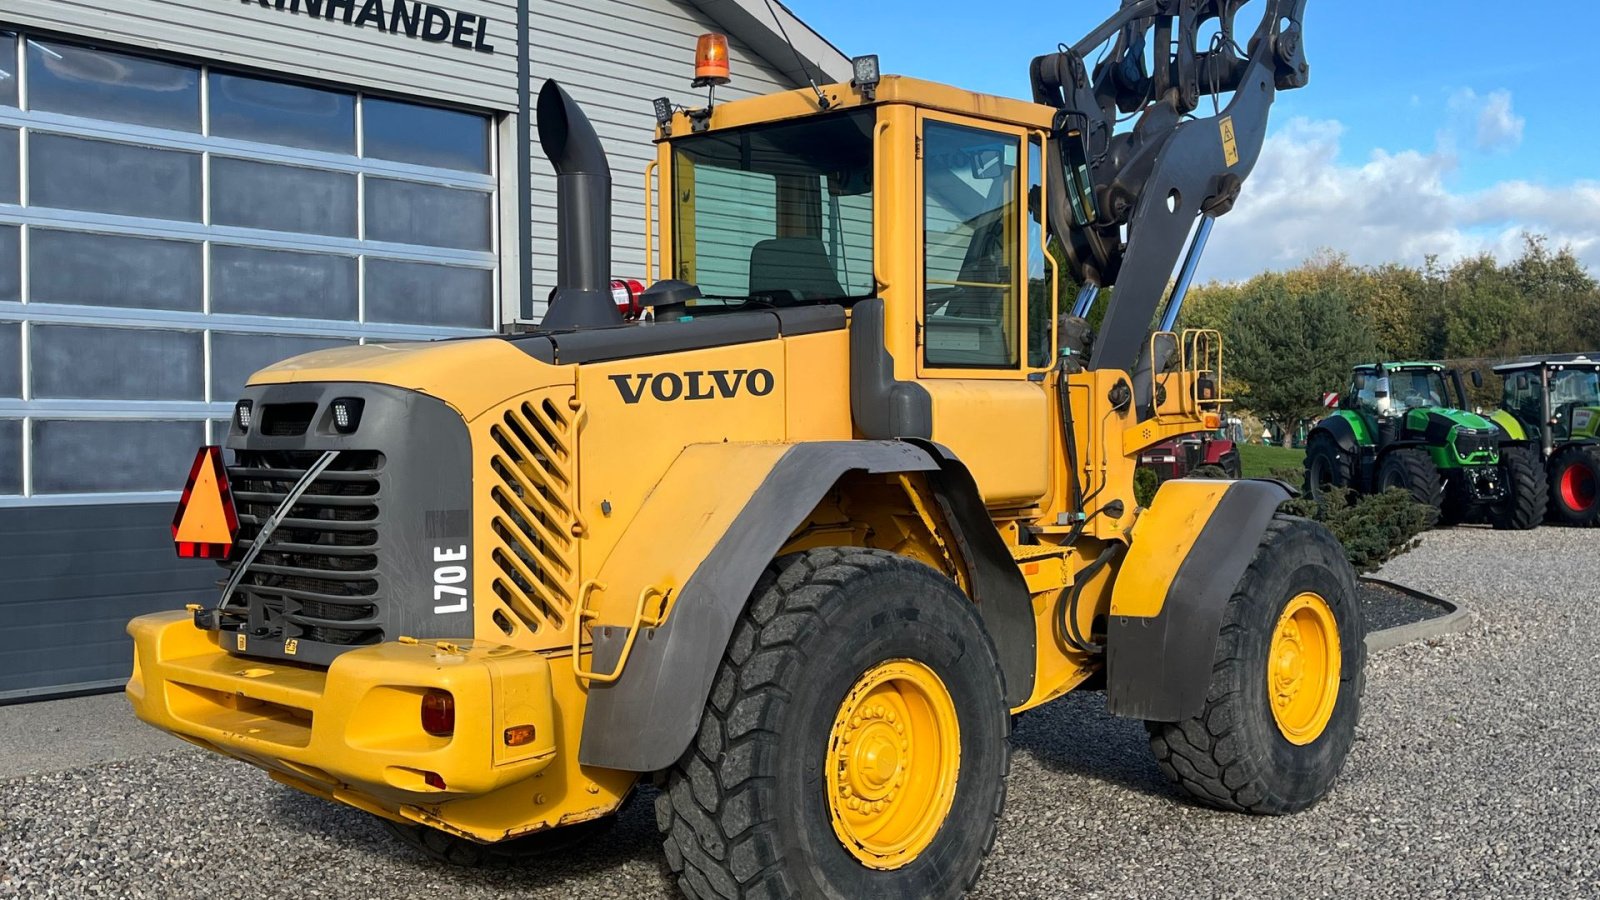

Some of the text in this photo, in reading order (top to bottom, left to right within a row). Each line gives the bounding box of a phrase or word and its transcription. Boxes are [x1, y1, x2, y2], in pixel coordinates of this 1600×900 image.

[241, 0, 494, 52] HANDEL
[608, 368, 775, 404] VOLVO
[433, 544, 468, 614] L70E
